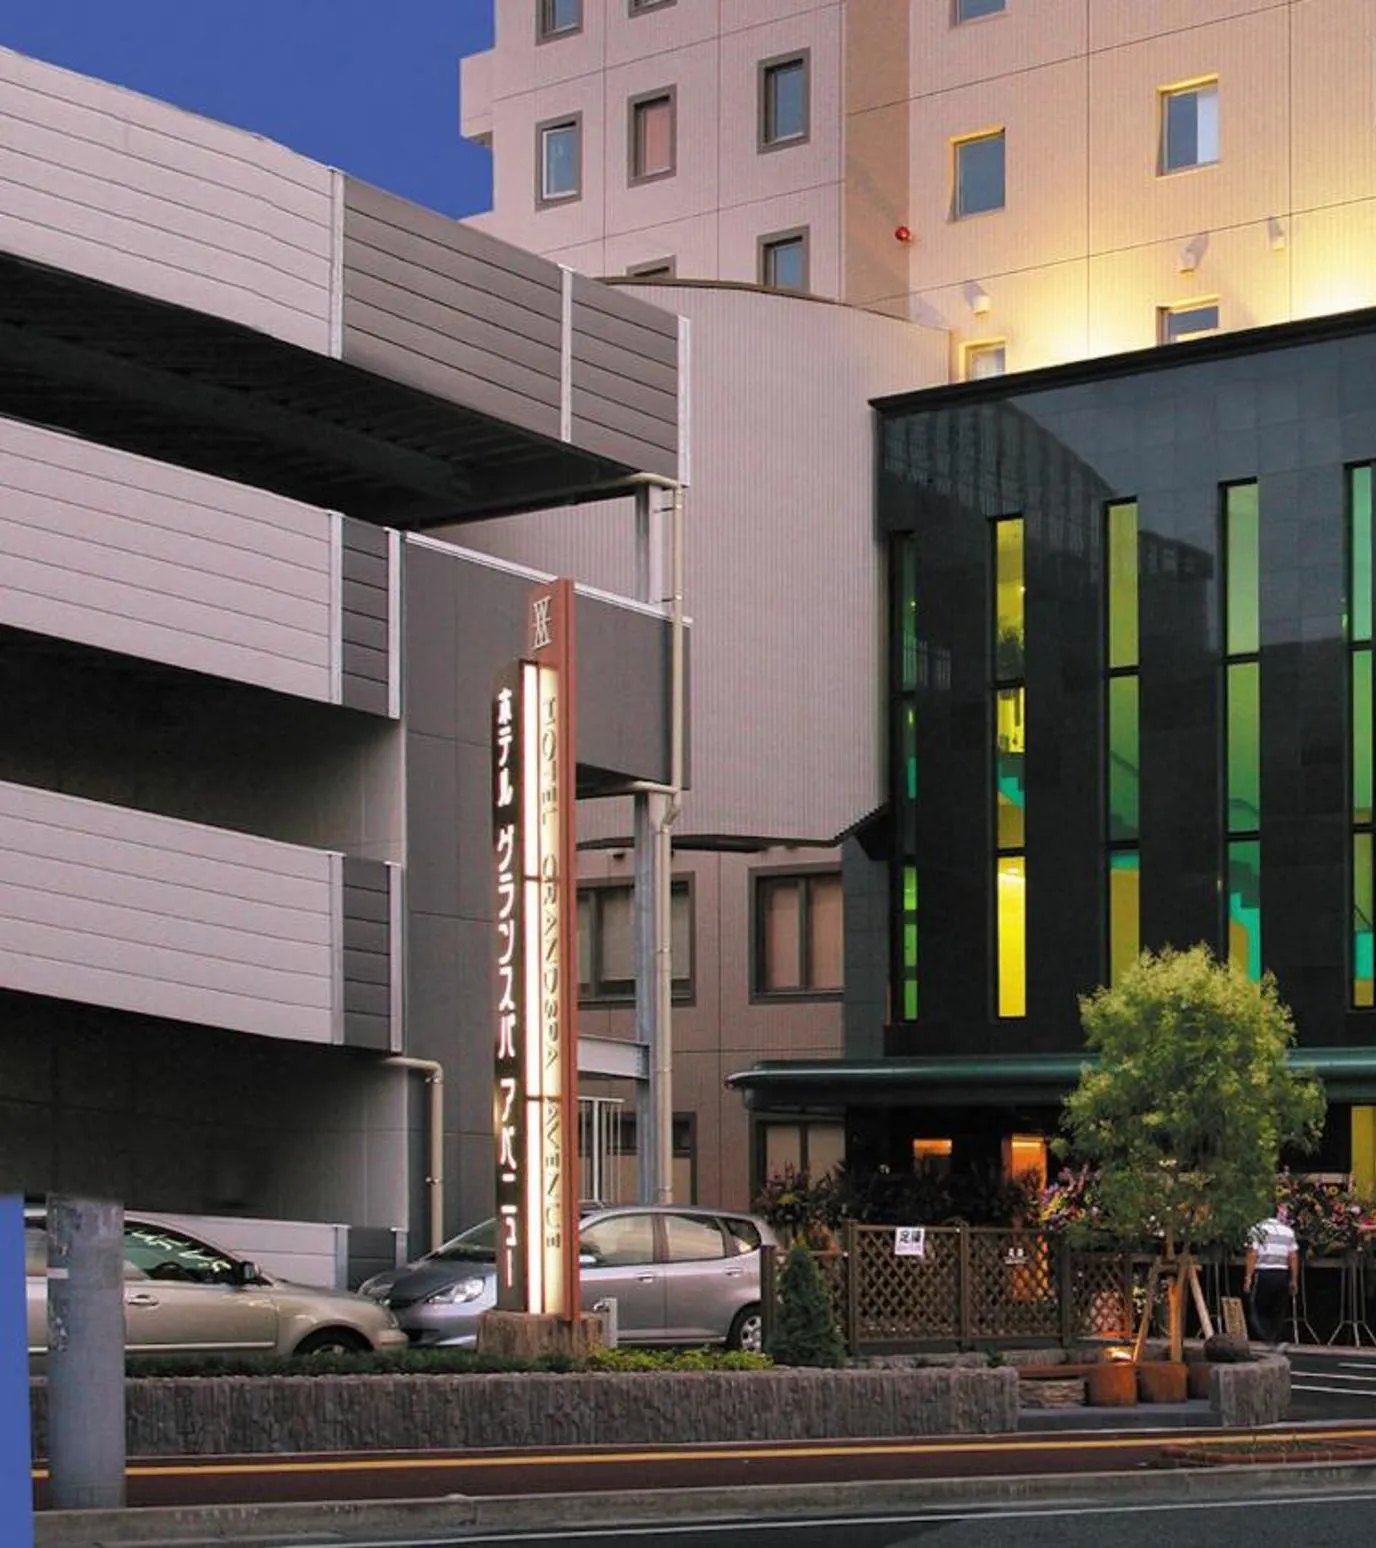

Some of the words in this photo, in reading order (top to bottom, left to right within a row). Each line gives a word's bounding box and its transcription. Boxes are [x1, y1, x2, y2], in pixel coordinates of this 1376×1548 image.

[497, 687, 514, 807] ホテル
[542, 697, 557, 826] HOTEL
[498, 824, 515, 1060] グランスパ
[499, 1078, 518, 1288] アベニュー
[544, 1100, 561, 1249] AVENUE
